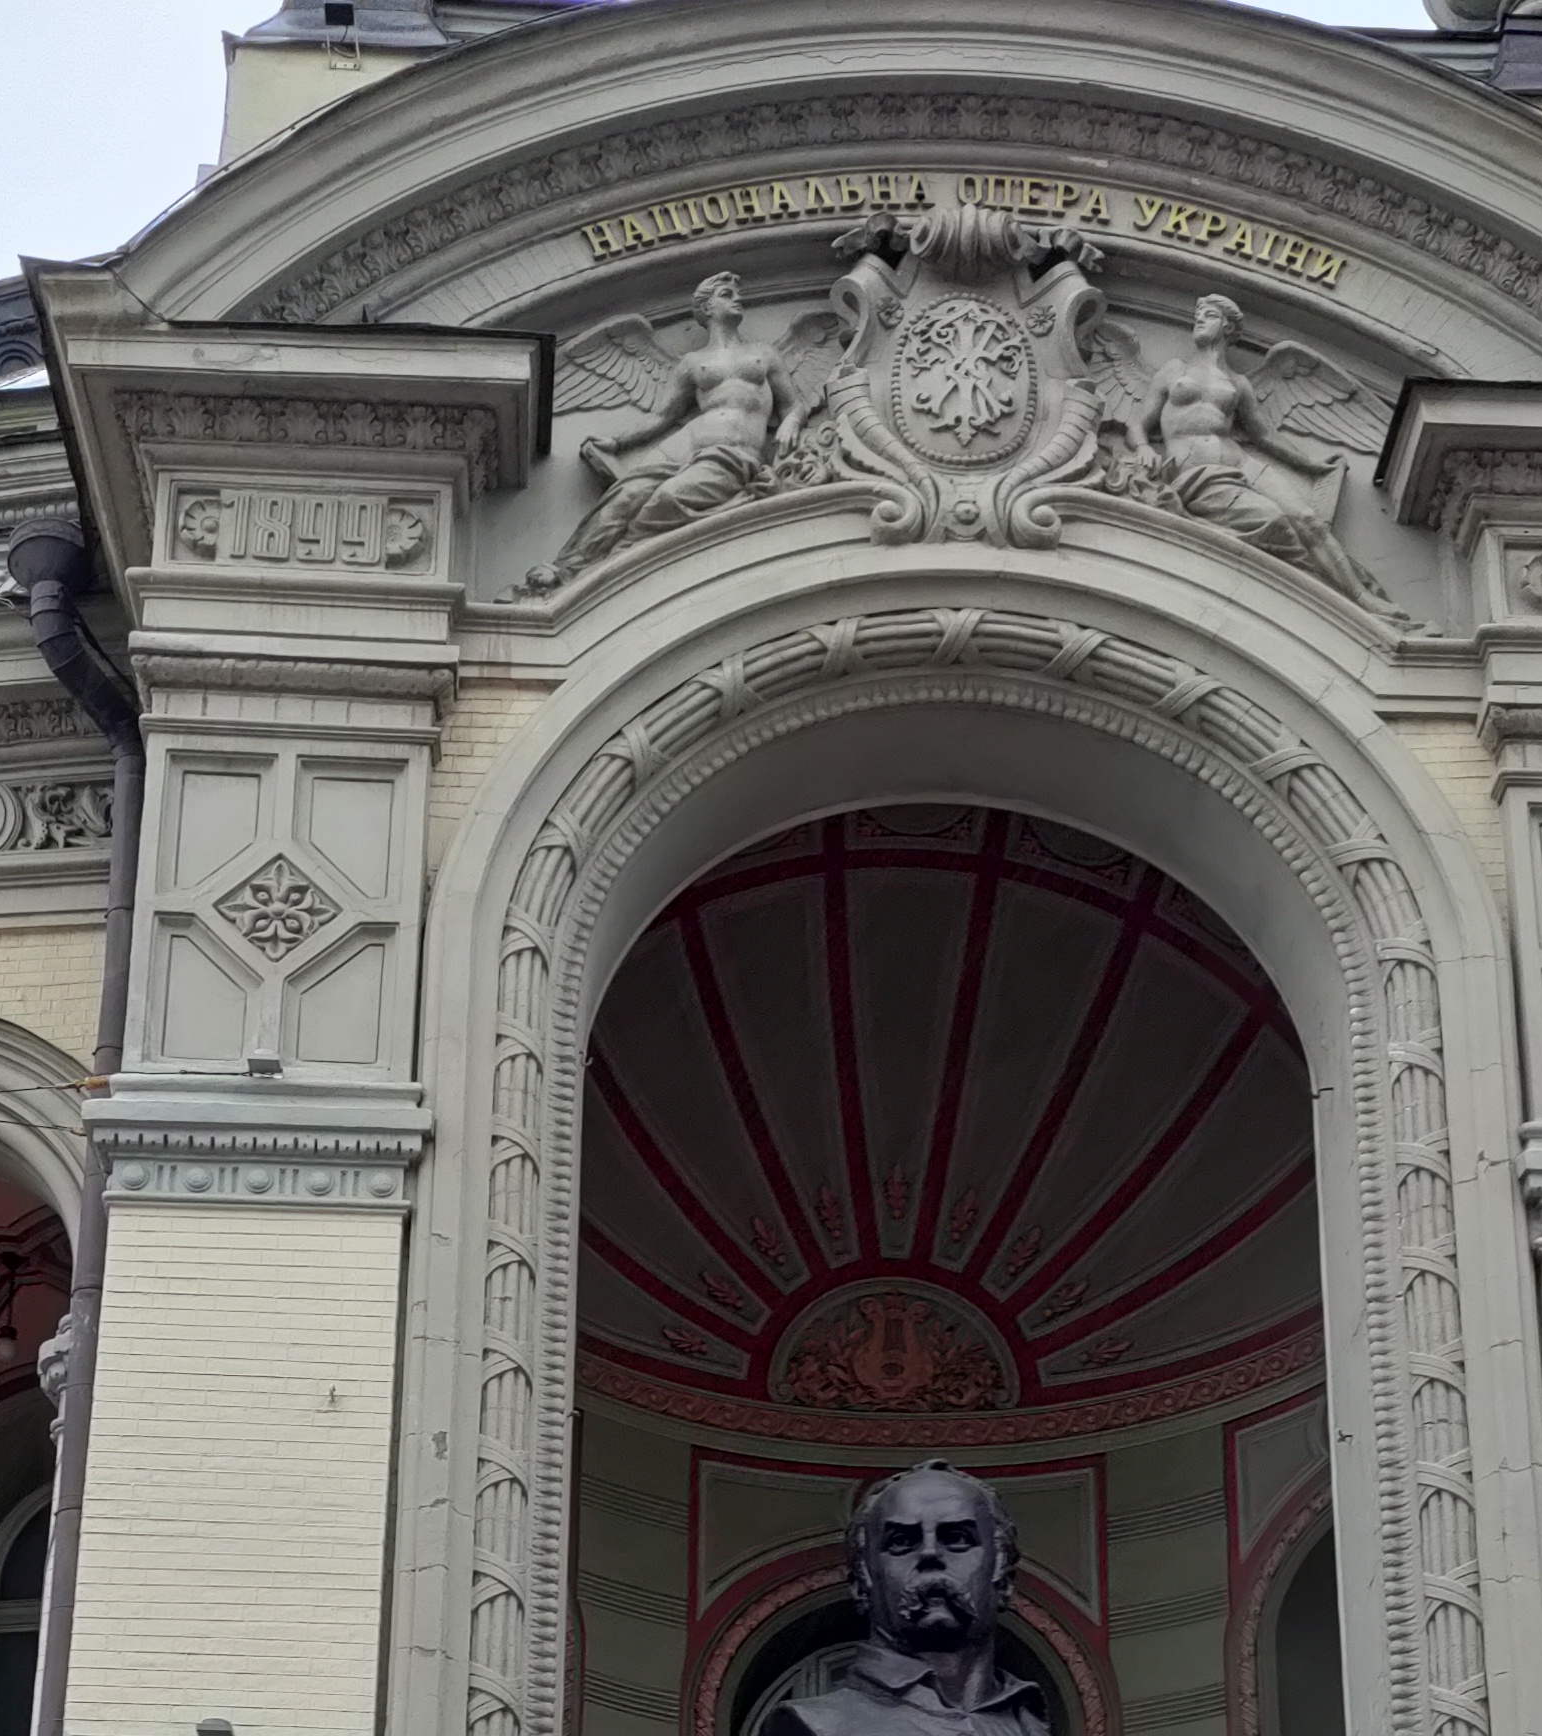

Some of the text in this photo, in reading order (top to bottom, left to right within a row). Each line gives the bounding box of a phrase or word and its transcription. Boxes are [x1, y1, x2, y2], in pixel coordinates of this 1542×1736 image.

[581, 174, 936, 261] НАЦІОНАЛЬНА
[958, 175, 1111, 224] ОПЕРА
[223, 494, 384, 565] 1899
